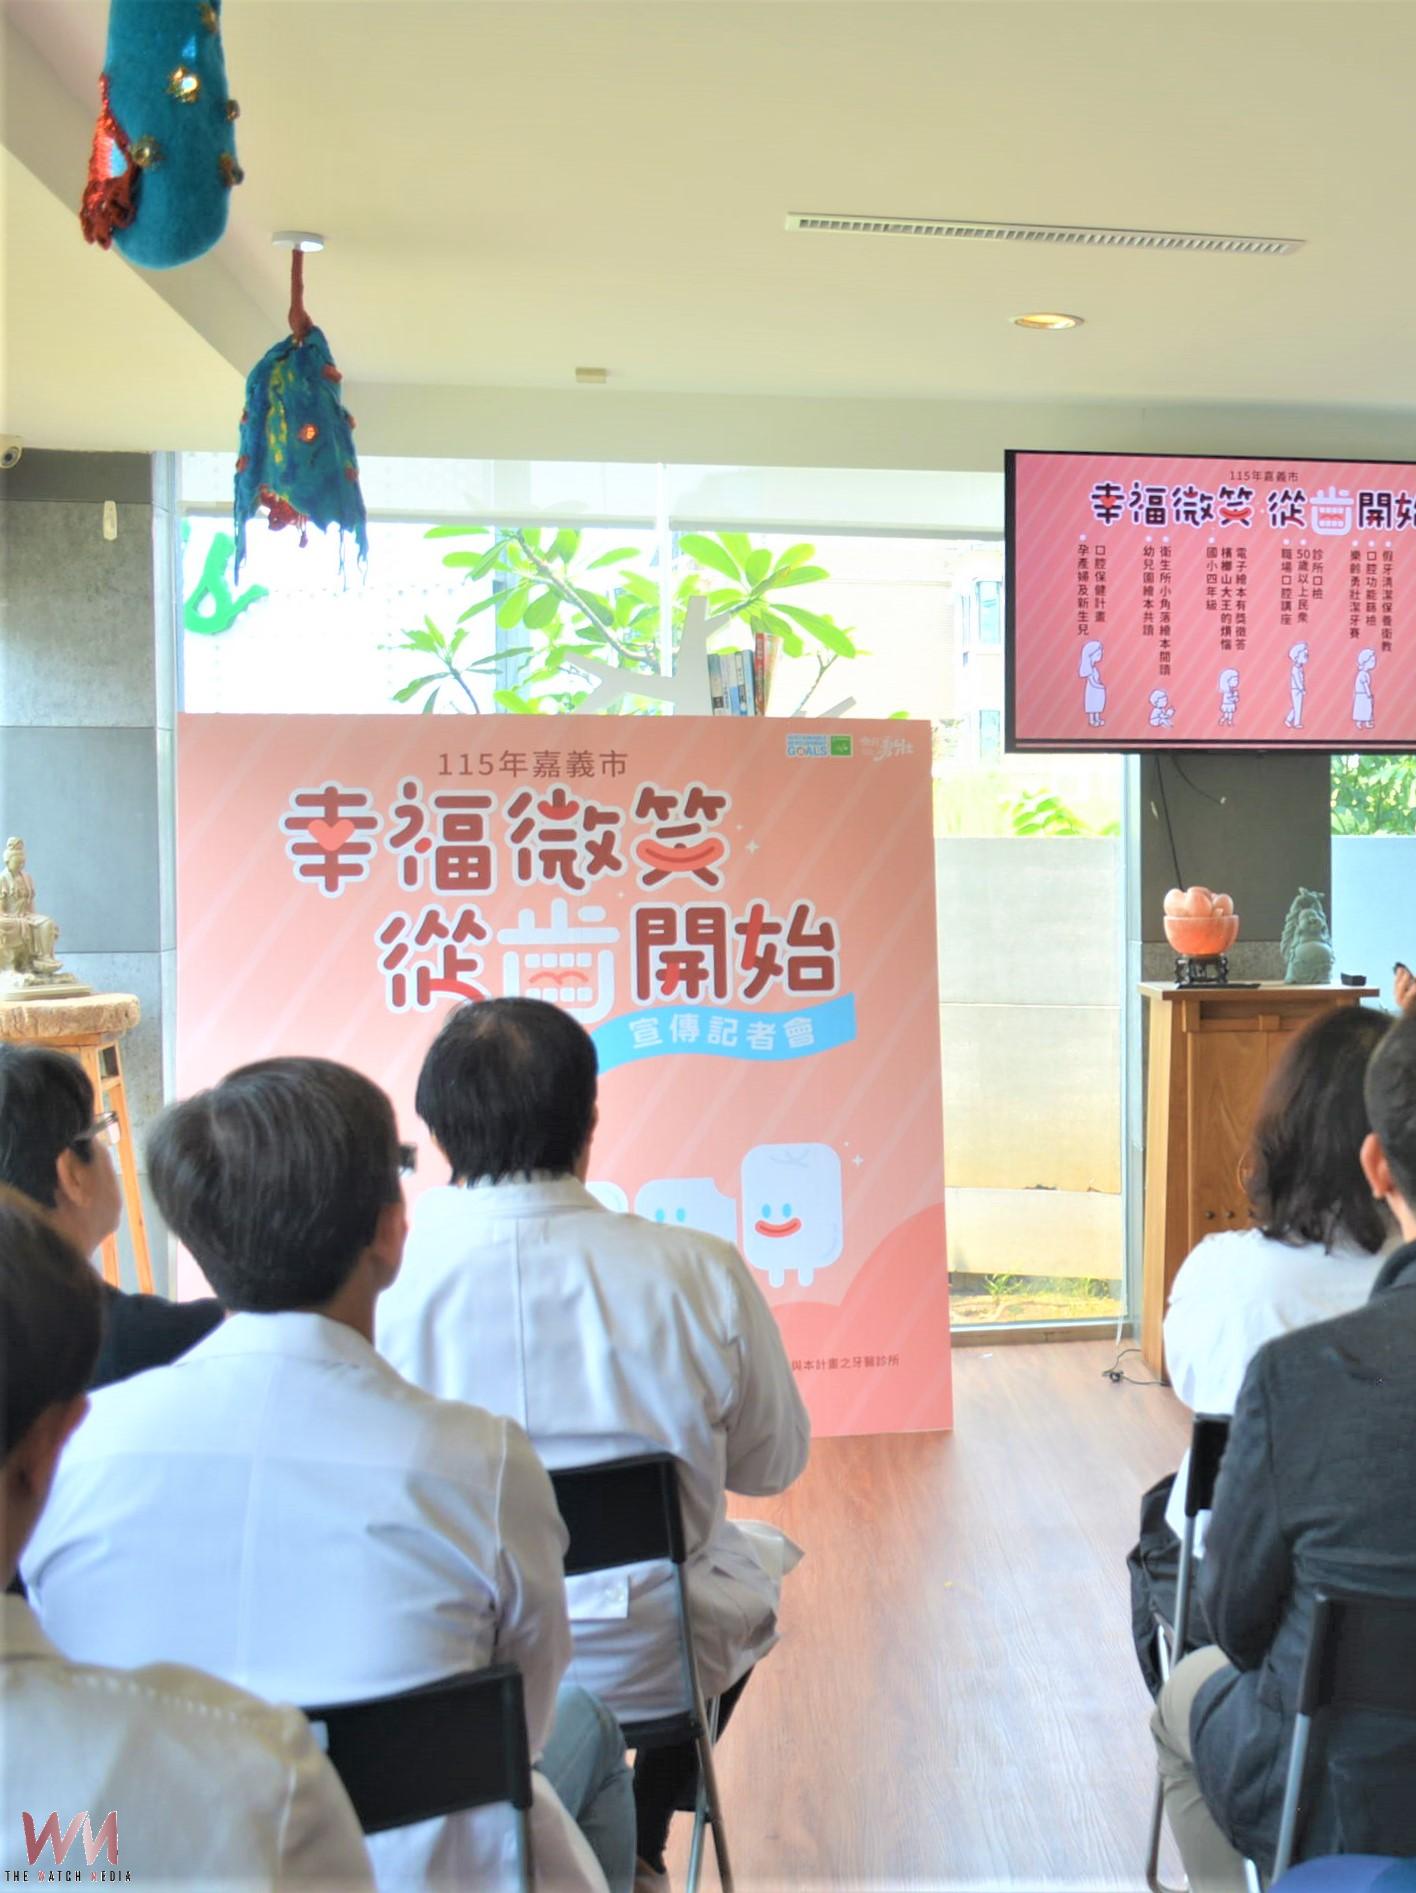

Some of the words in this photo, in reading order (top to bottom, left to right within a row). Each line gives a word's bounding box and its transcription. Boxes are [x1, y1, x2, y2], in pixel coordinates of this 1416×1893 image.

[1090, 481, 1254, 528] 幸福微笑
[1229, 471, 1300, 483] 115年嘉義市
[1077, 544, 1089, 636] 孕產婦及新生兒
[1094, 545, 1106, 623] 口腔保健計畫
[1206, 547, 1218, 611] 國小四年級
[1280, 548, 1292, 625] 職場口腔講座
[1312, 549, 1323, 599] 診所口檢
[1366, 551, 1377, 626] 口腔功能篩檢
[438, 750, 629, 778] 115年嘉義市
[282, 779, 729, 893] 幸福微笑
[628, 1012, 815, 1050] 宣傳記者會
